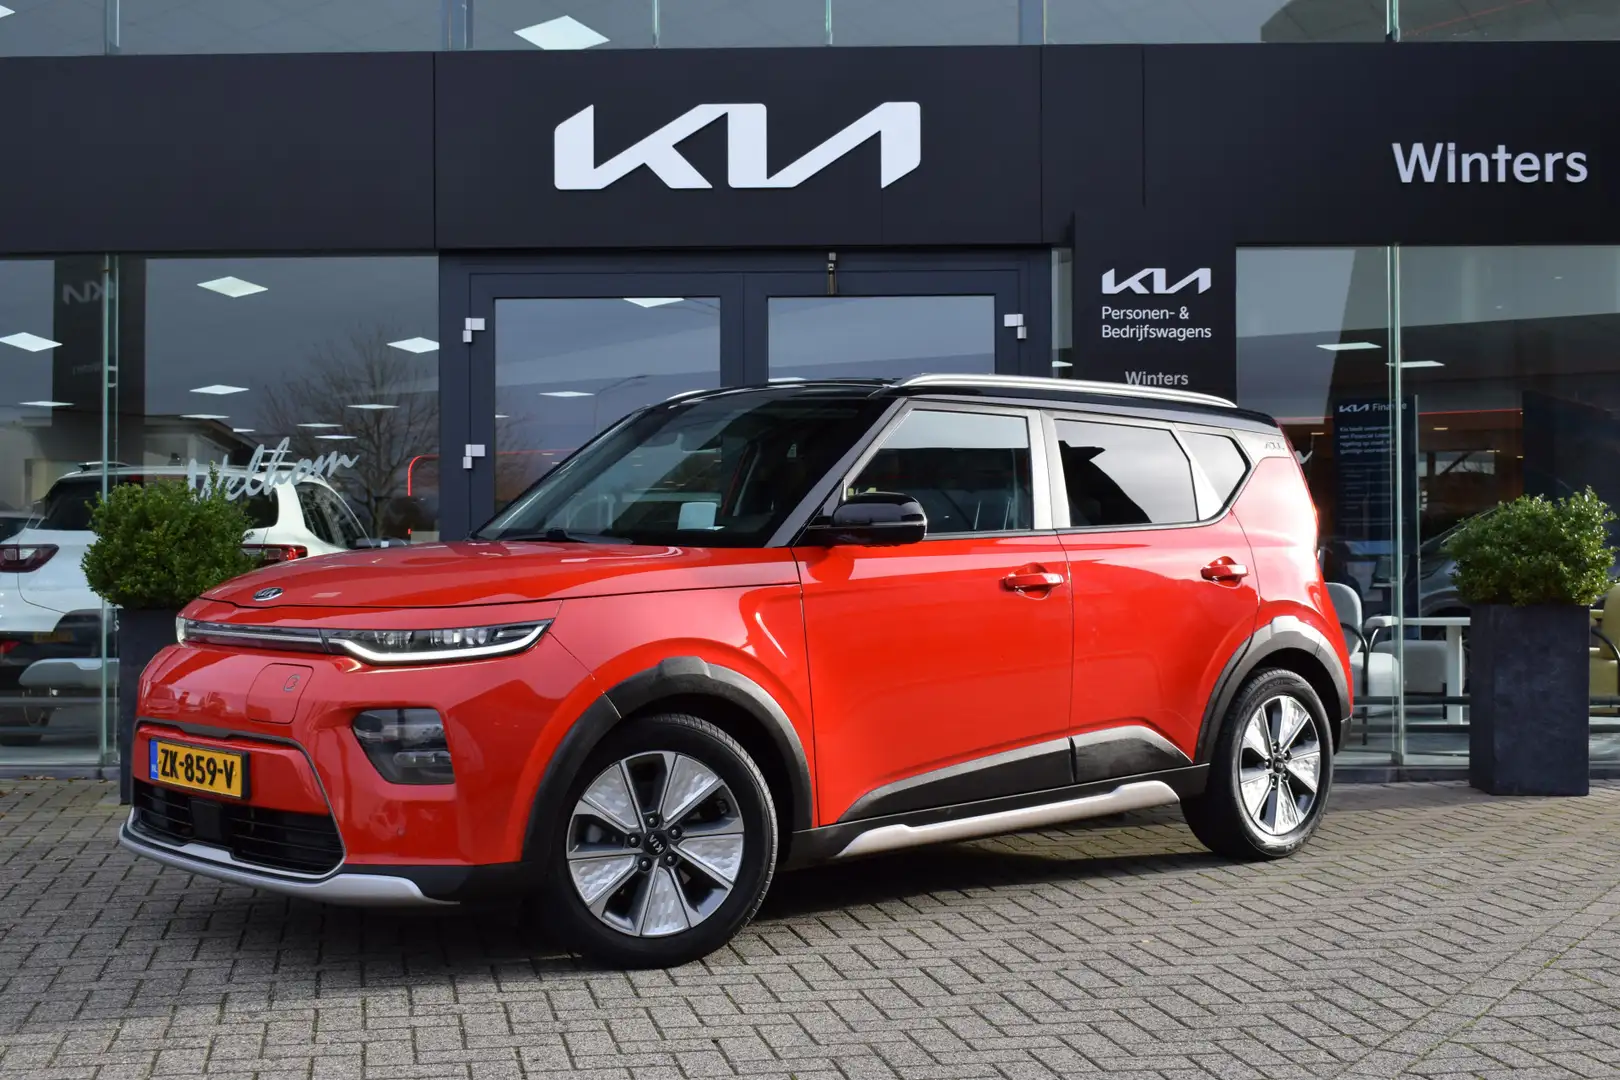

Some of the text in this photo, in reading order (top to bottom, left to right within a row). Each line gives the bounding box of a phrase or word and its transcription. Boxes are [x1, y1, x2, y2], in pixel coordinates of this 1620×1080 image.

[554, 102, 921, 190] KIA
[1392, 142, 1588, 183] Winters
[1102, 268, 1211, 294] KIA
[1102, 306, 1189, 319] Personen- &
[1102, 325, 1212, 341] Bedrijfswagens
[1125, 371, 1189, 385] Winters
[1339, 404, 1369, 412] KIA
[161, 748, 235, 789] ZK-859-V
[649, 834, 664, 853] KIA
